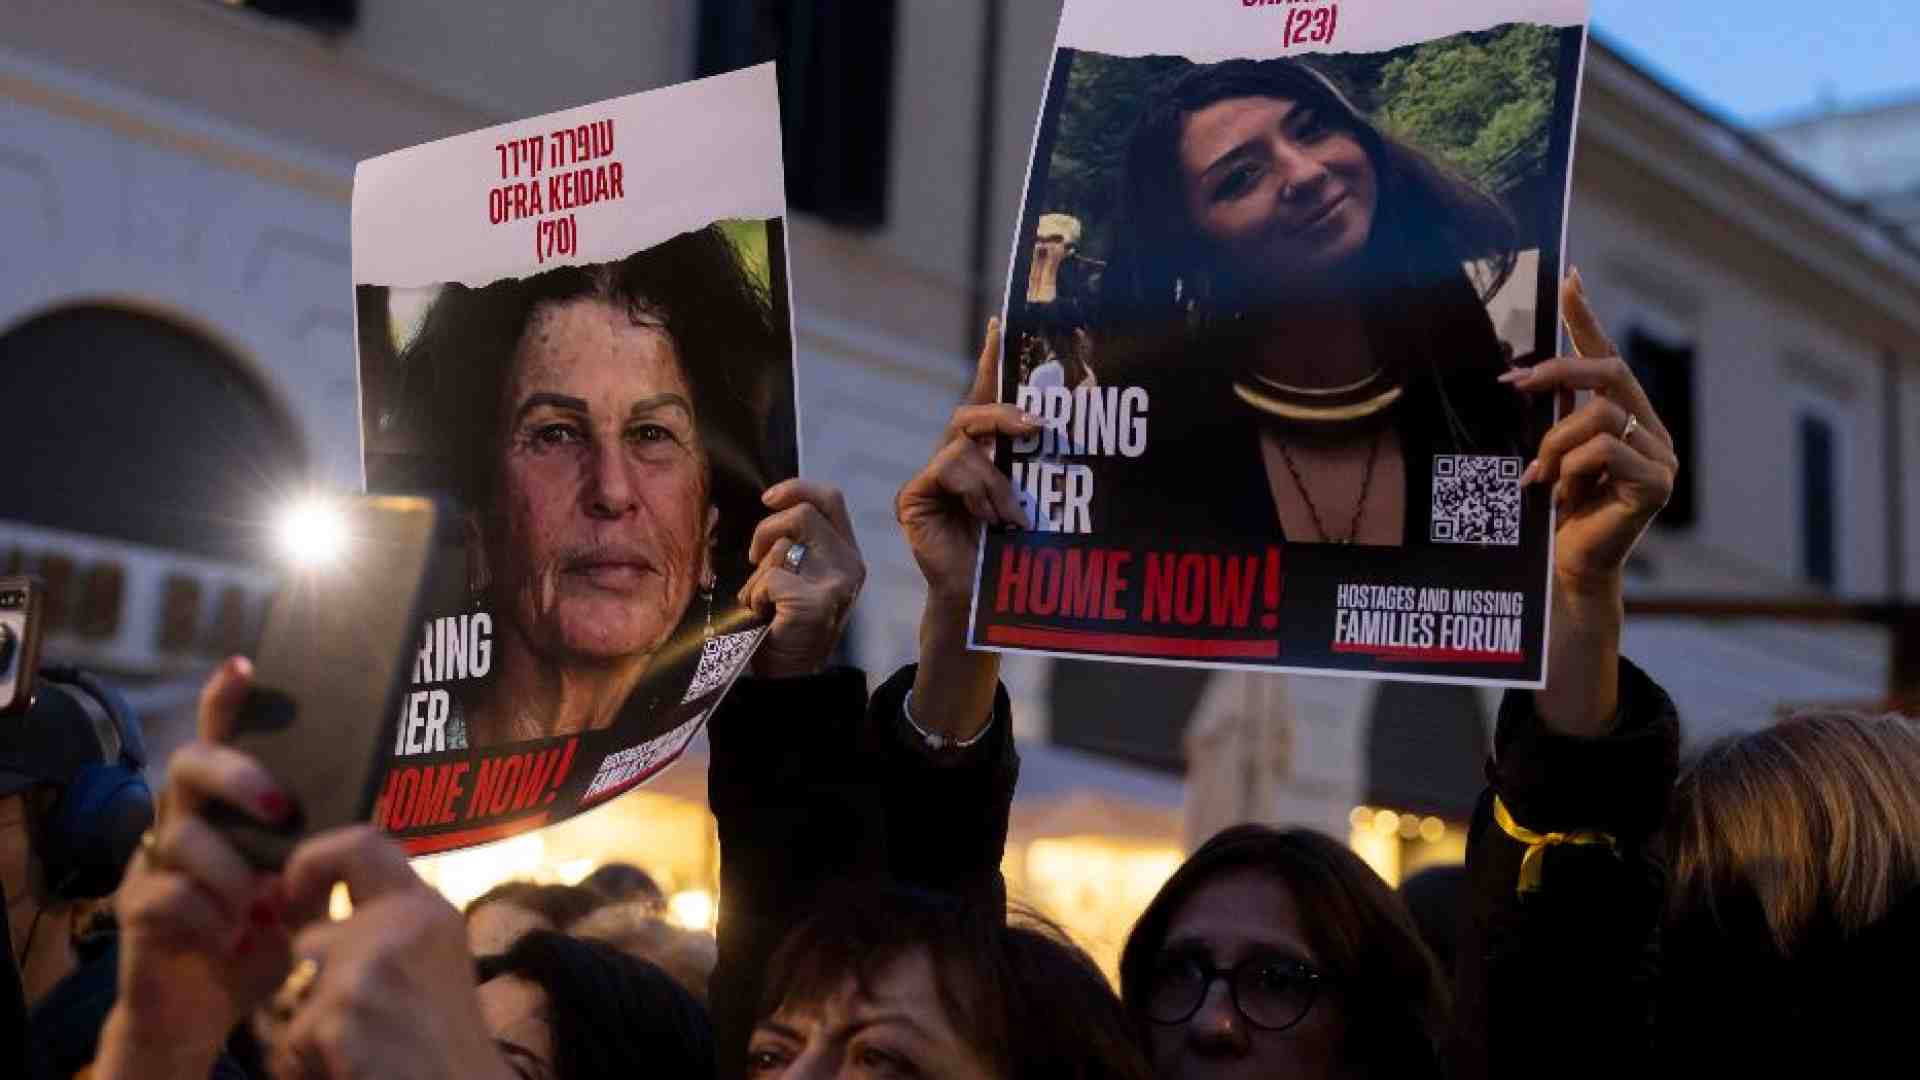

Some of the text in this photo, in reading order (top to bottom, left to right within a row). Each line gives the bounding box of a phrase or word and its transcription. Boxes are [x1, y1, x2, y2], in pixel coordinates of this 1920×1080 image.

[1283, 4, 1337, 48] (23)
[495, 119, 616, 179] עופרה קידר
[489, 161, 625, 225] OFRA KEIDAR
[536, 214, 577, 263] (70)
[1012, 462, 1094, 533] HER
[995, 544, 1281, 632] HOME NOW!
[1337, 584, 1524, 616] HOSTAGES AND MISSING
[412, 612, 493, 684] RING
[1335, 609, 1522, 654] FAMILIES FORUM
[465, 736, 580, 819] NOW!
